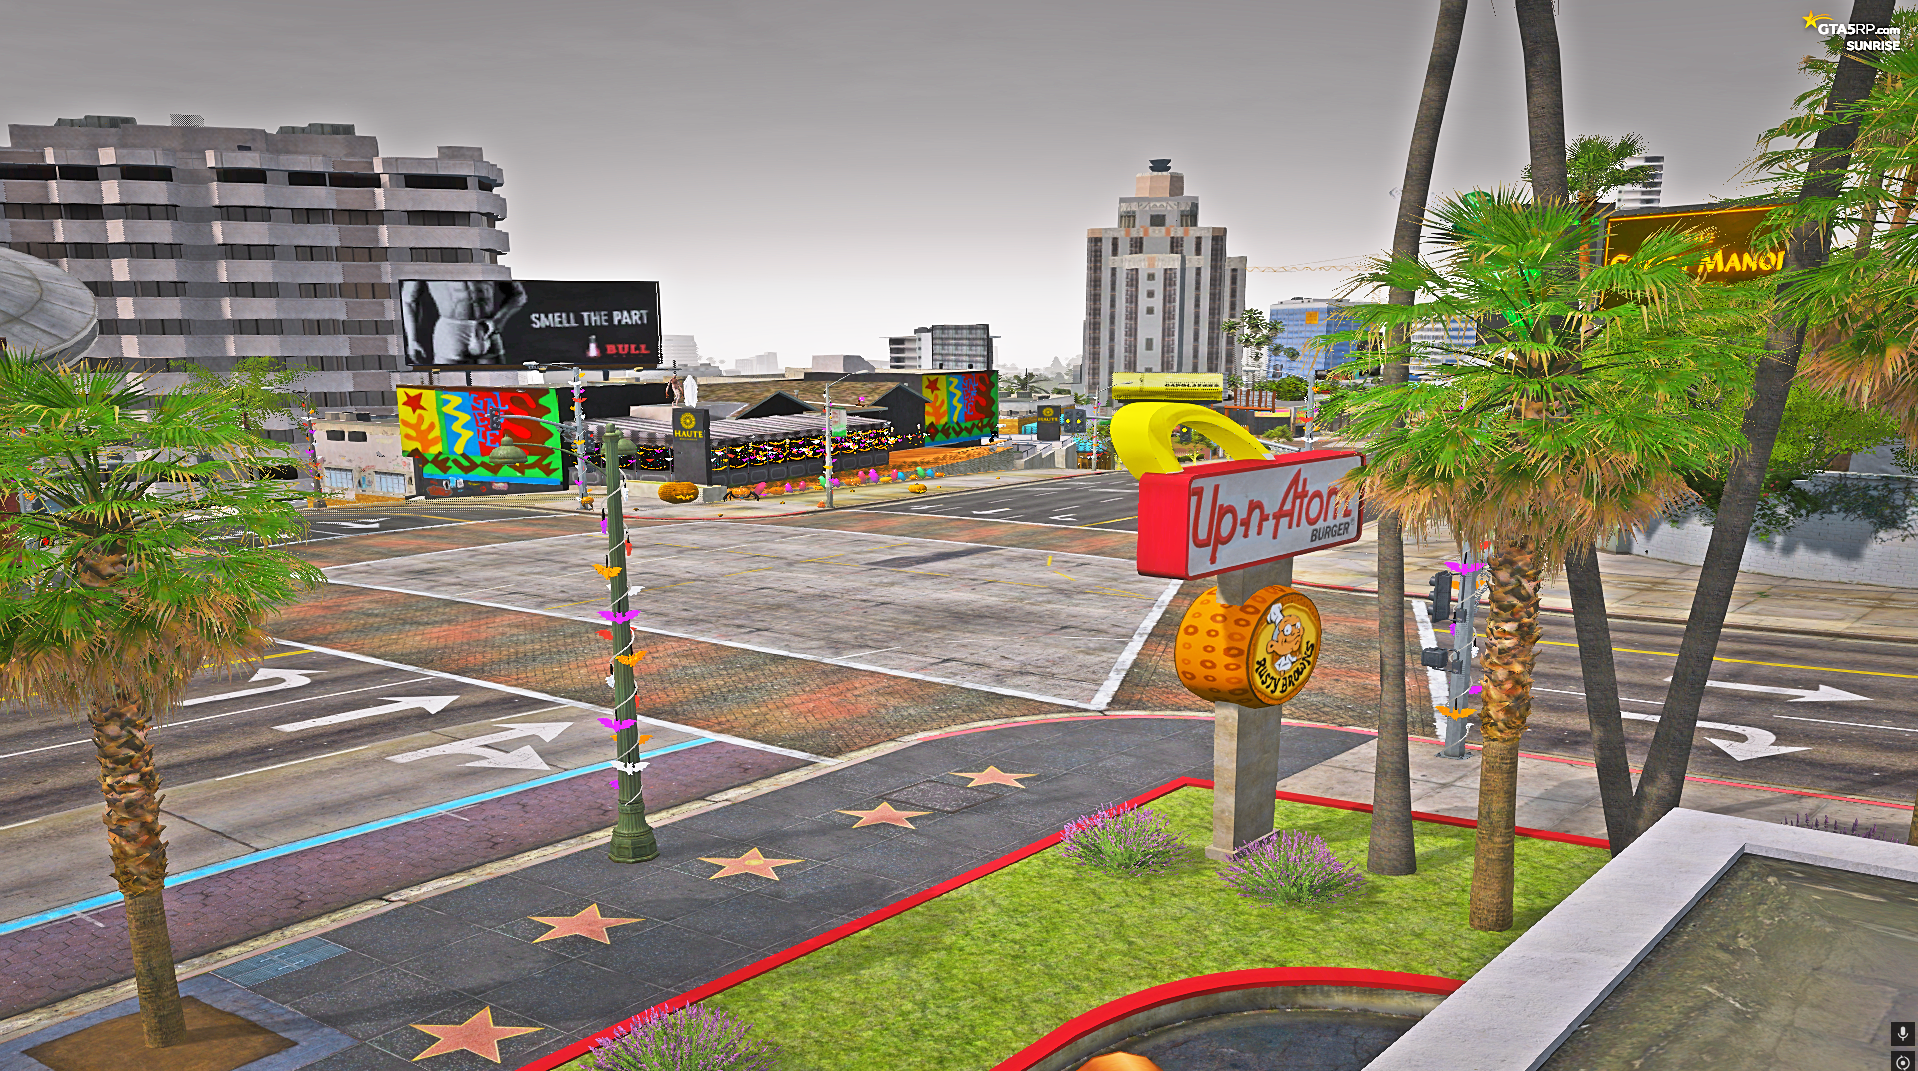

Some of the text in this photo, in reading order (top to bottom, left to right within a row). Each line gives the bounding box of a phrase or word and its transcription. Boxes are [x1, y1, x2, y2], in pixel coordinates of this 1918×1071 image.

[530, 309, 649, 328] SMELL THE PART
[605, 343, 651, 354] BULL
[674, 429, 704, 438] HAUTE
[1310, 522, 1350, 542] BURGER
[1255, 640, 1315, 694] RUSTY BROWNS
